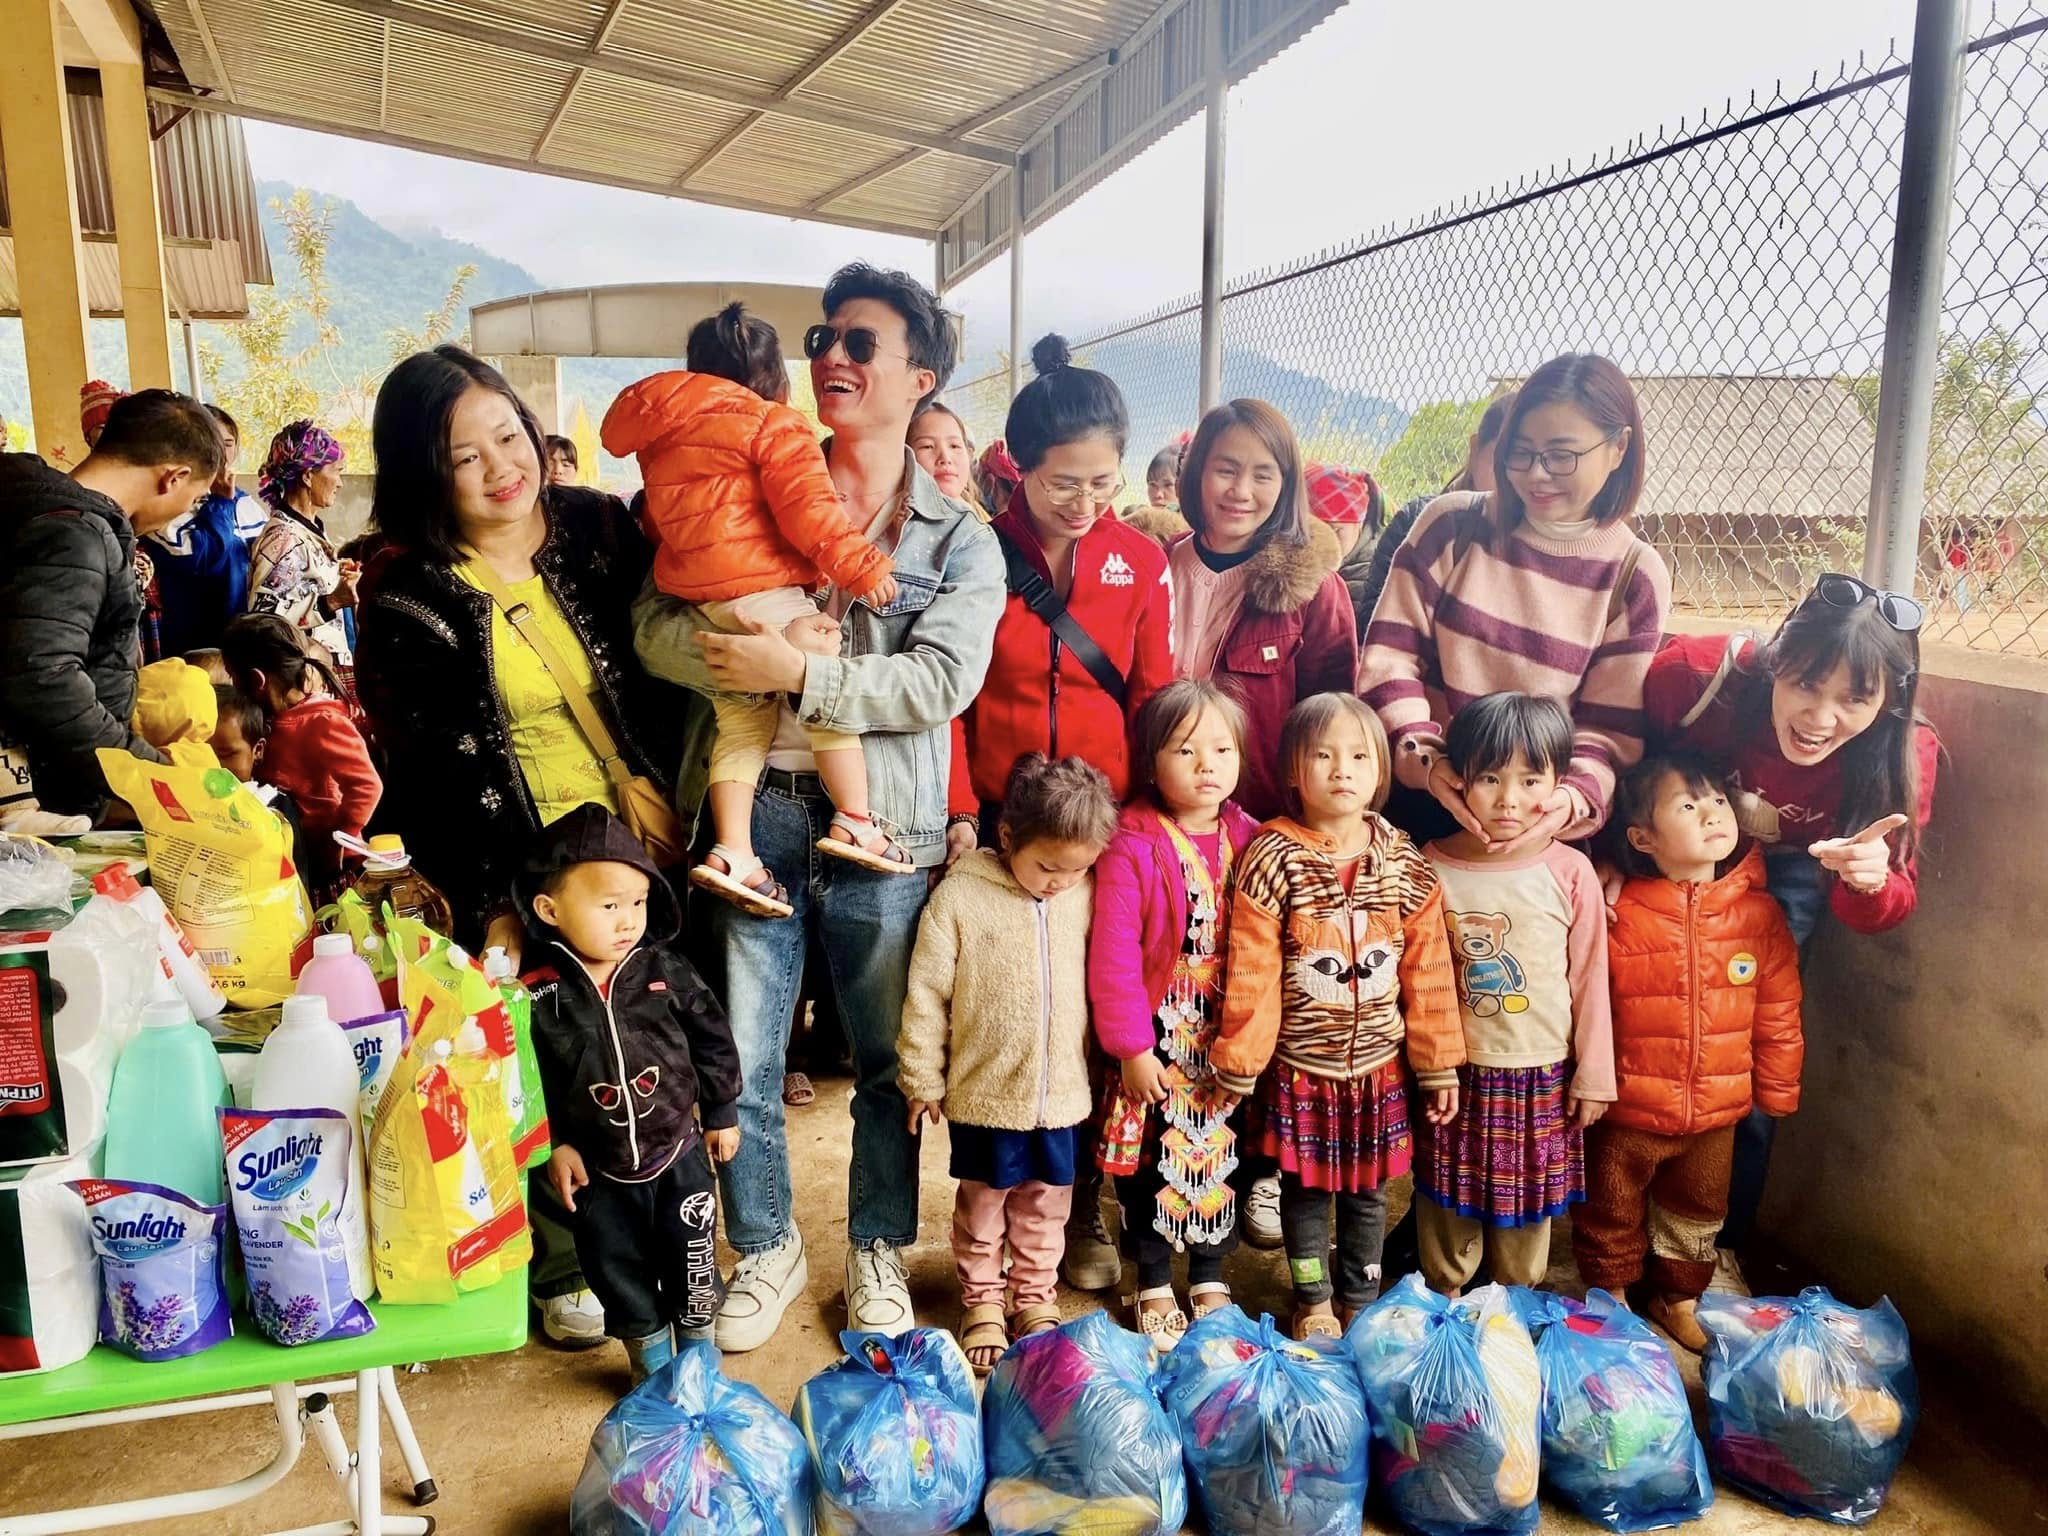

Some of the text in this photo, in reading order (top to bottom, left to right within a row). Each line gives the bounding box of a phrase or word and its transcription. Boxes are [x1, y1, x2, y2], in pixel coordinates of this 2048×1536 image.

[1101, 573, 1134, 586] Kappa
[236, 1133, 323, 1191] Sunlight
[91, 1212, 187, 1242] Sunlight
